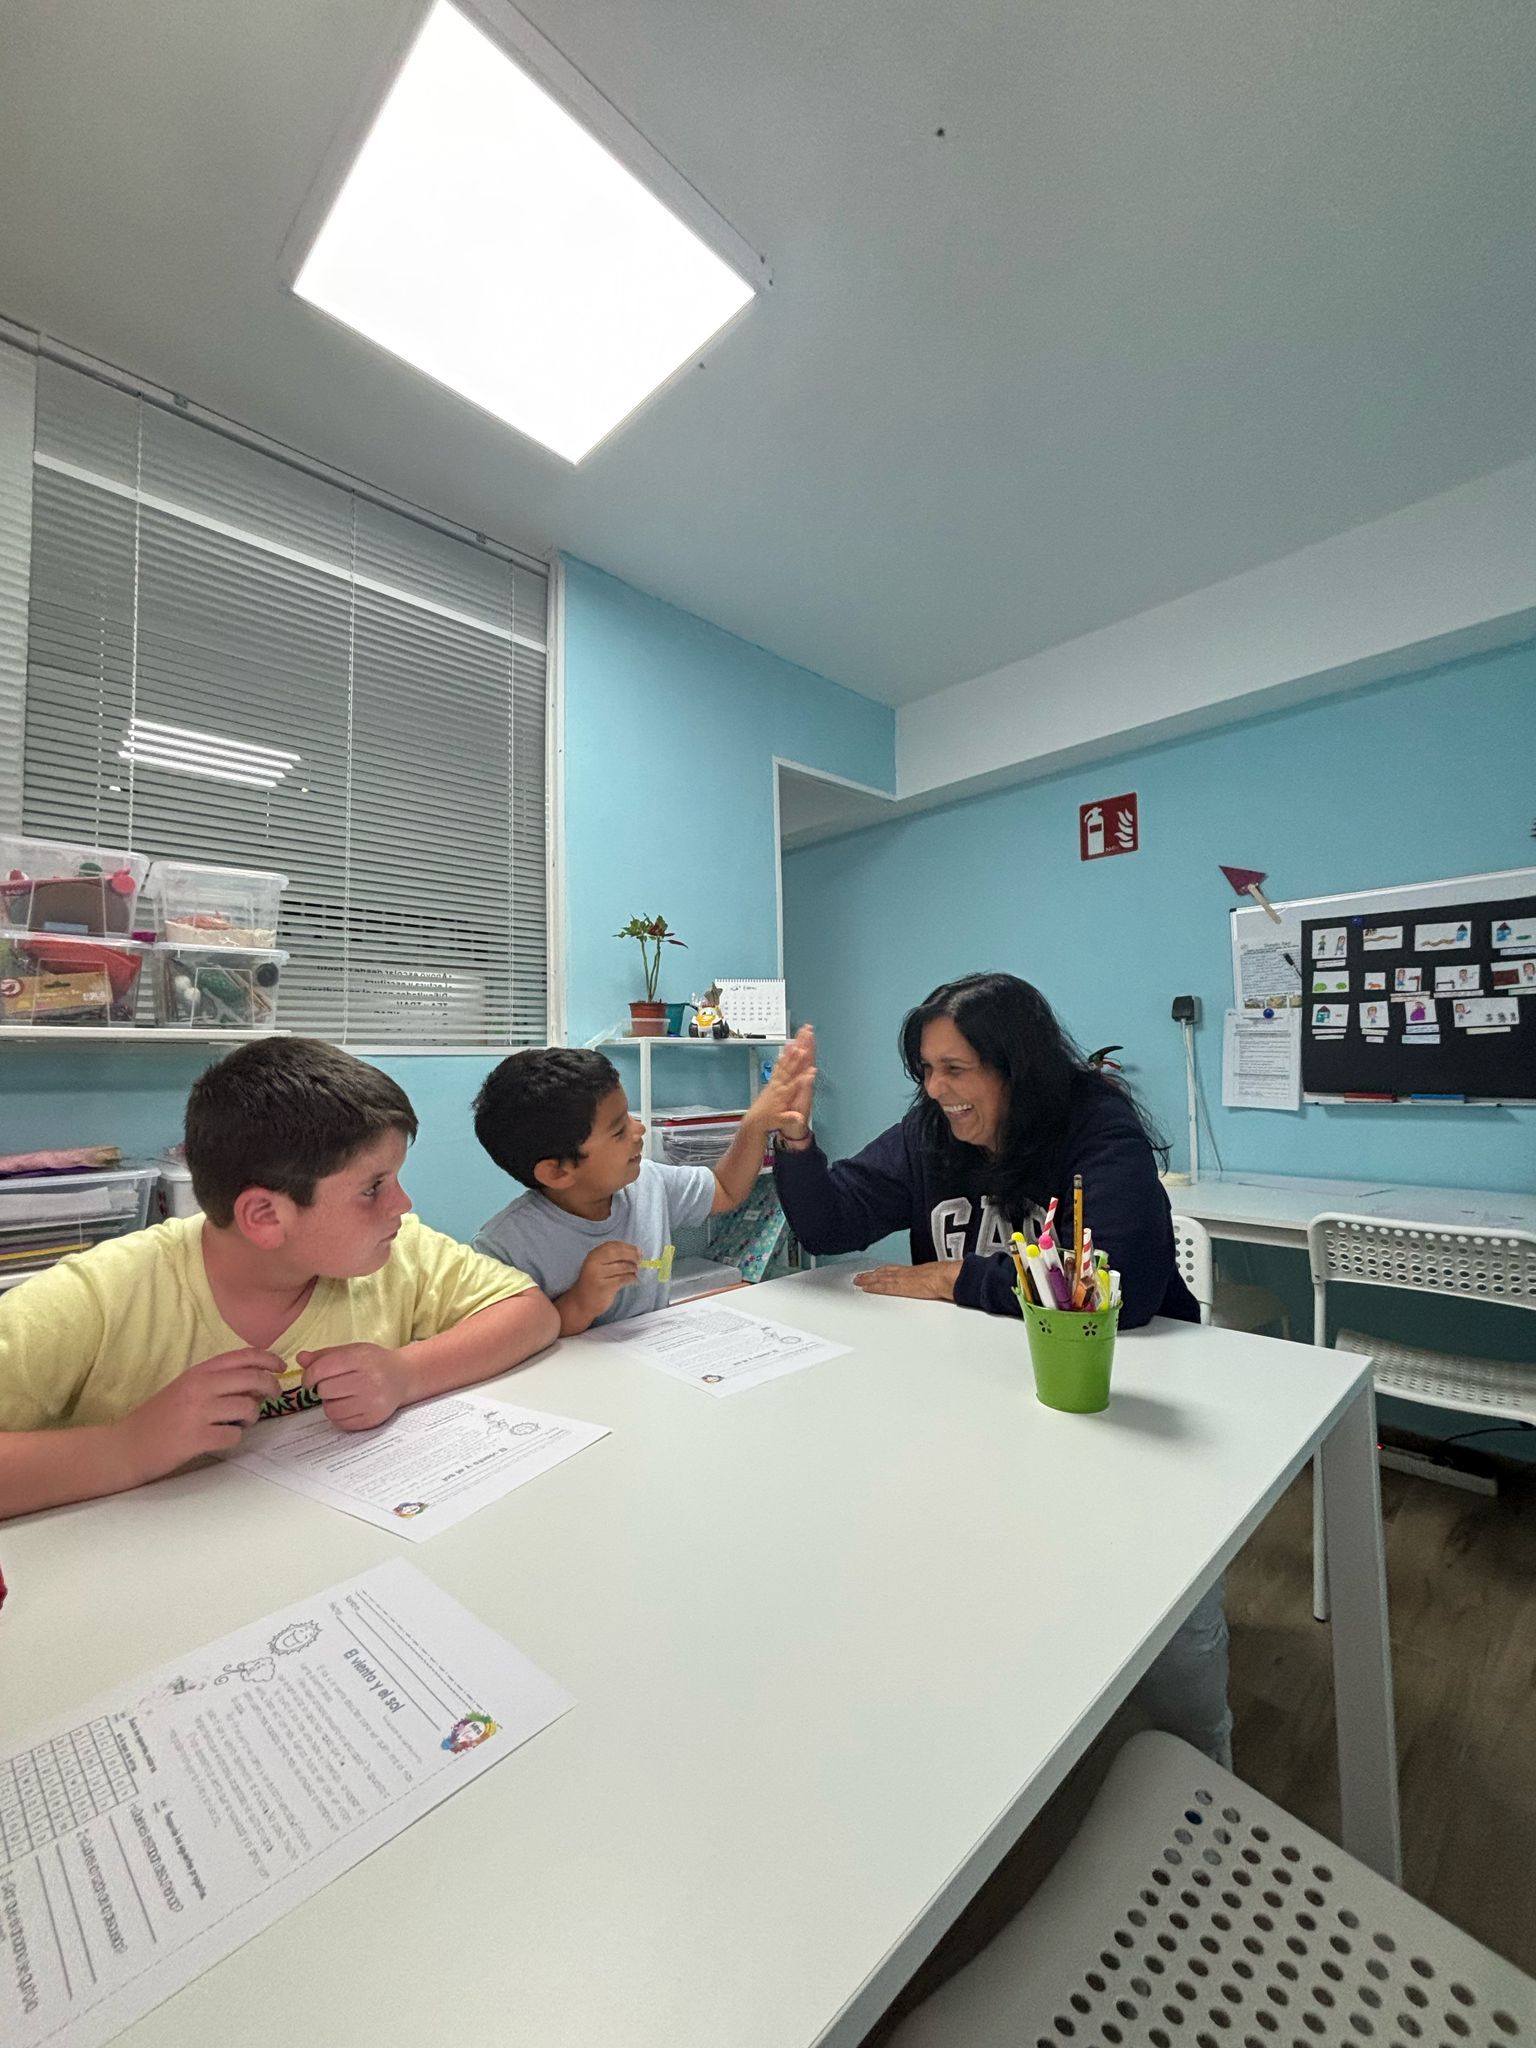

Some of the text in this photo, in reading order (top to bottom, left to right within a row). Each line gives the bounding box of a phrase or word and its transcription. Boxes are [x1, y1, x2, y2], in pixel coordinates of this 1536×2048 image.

[343, 1648, 359, 1660] El
[351, 1654, 377, 1683] viento
[368, 1680, 384, 1692] y
[377, 1688, 394, 1701] el
[384, 1699, 406, 1713] sol
